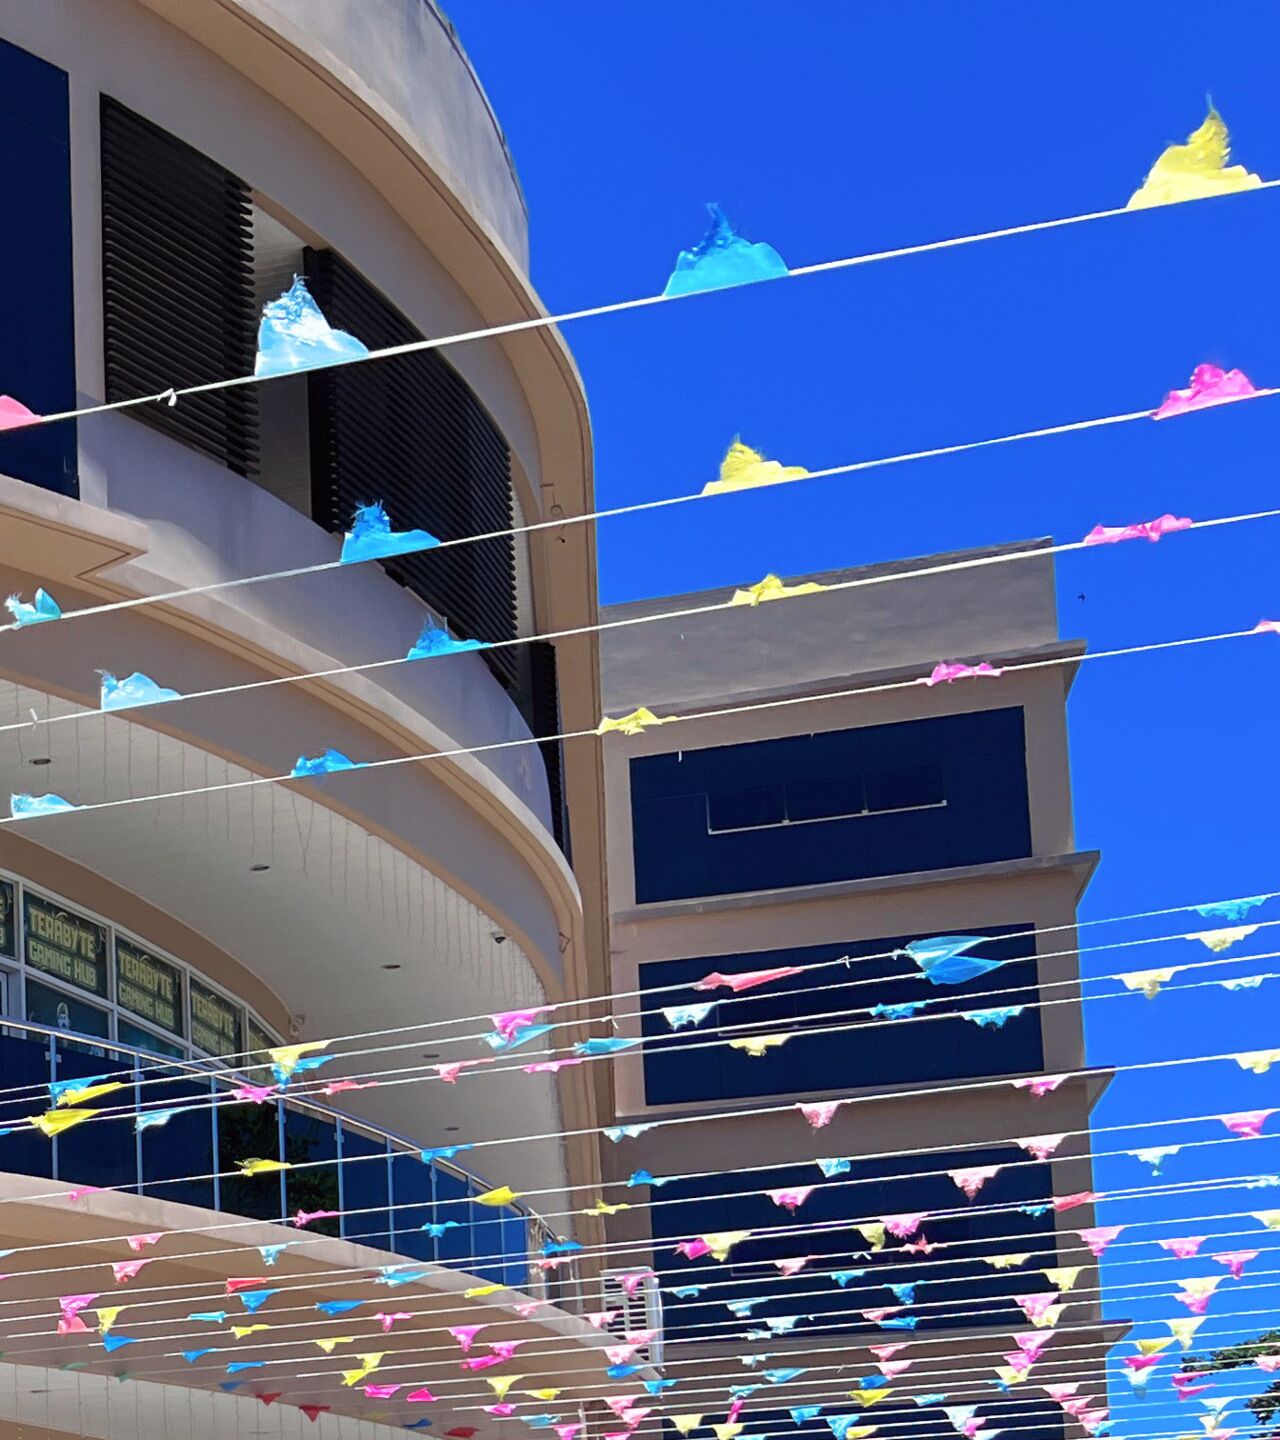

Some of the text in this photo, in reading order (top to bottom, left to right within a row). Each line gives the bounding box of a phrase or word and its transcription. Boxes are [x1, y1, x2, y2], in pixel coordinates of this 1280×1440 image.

[28, 907, 96, 960] TERABYTE
[28, 940, 97, 987] GAMING HUB
[117, 950, 174, 1003] TERABYTE
